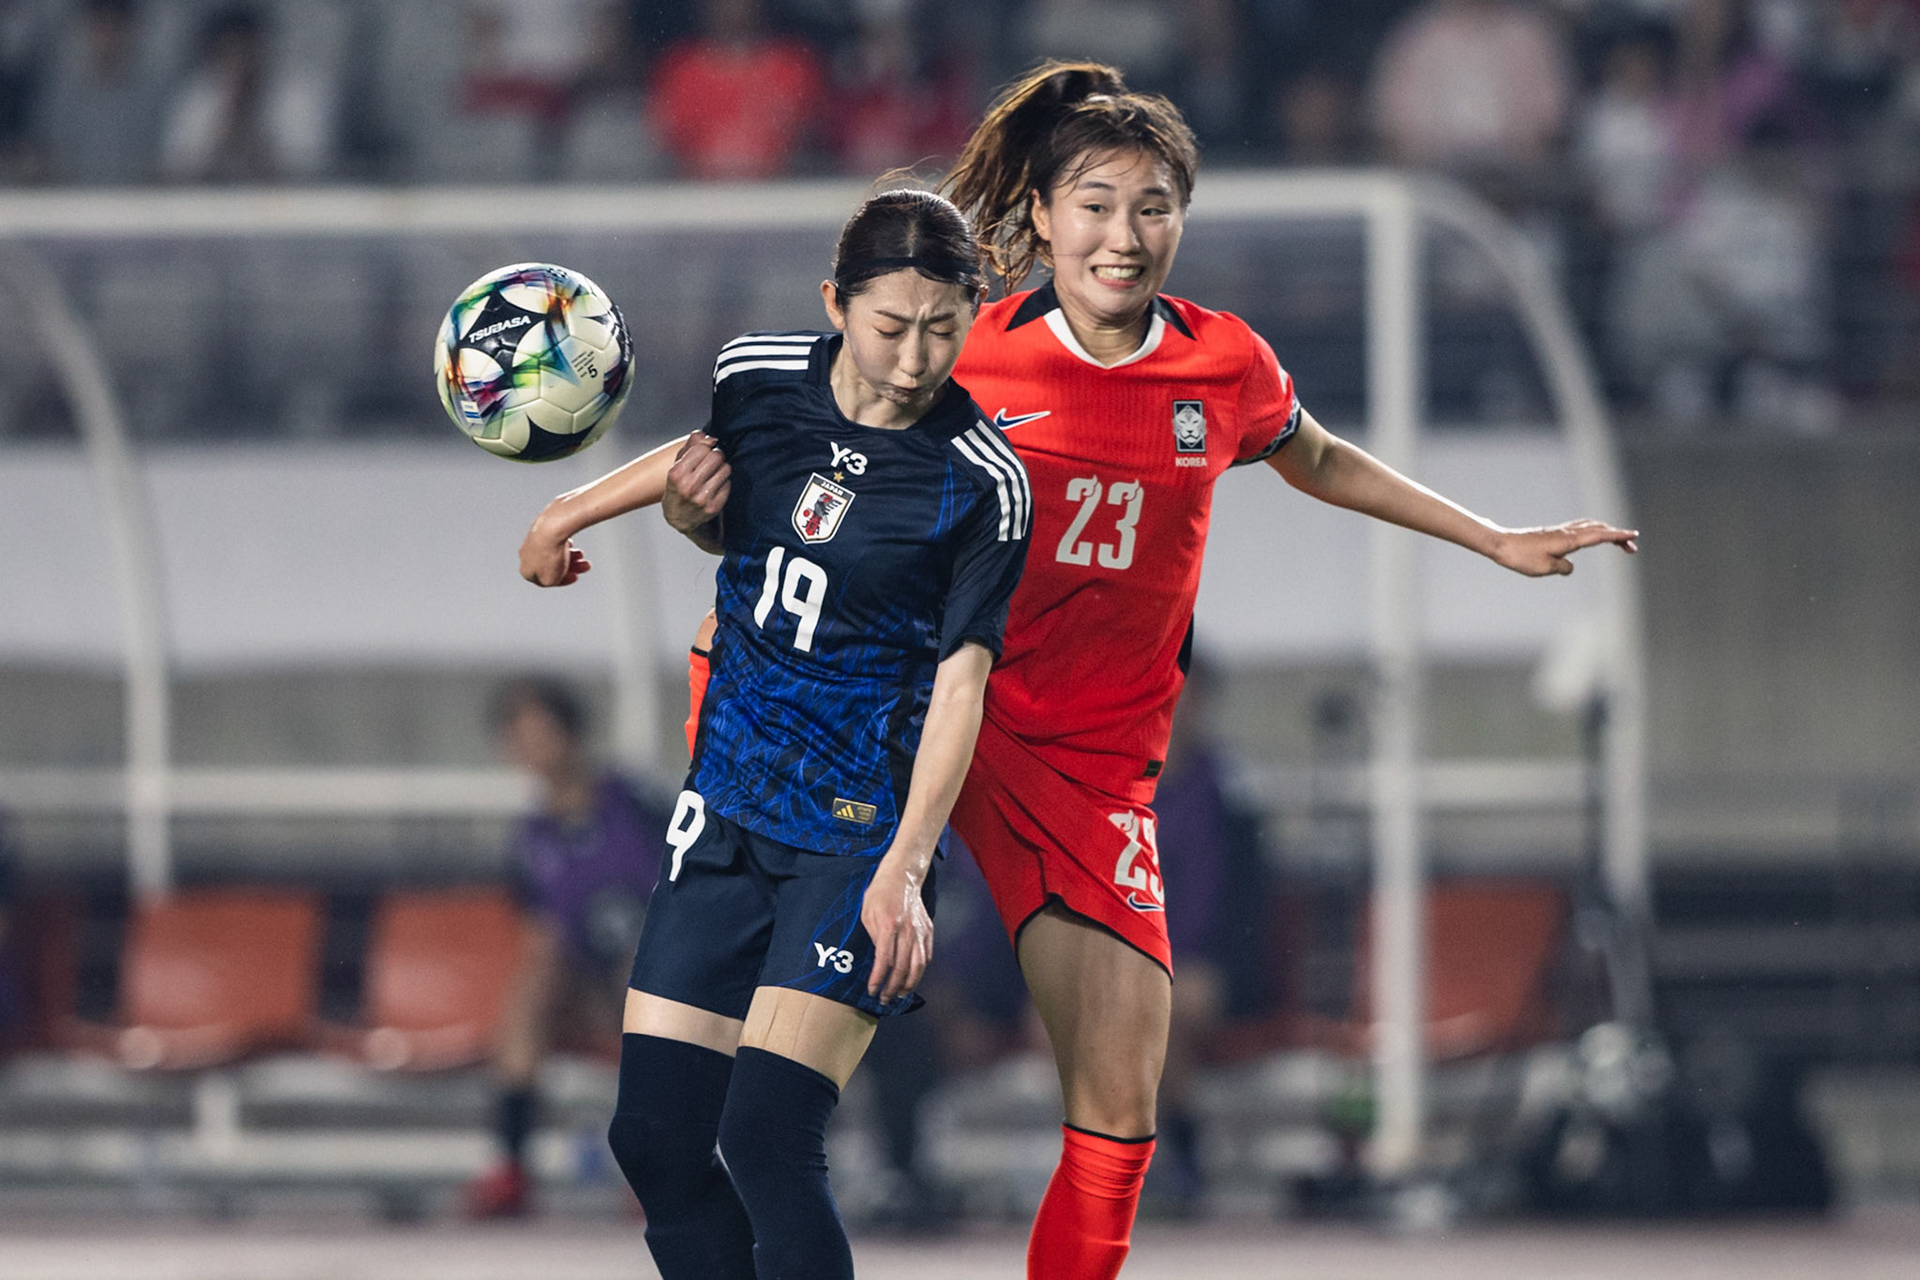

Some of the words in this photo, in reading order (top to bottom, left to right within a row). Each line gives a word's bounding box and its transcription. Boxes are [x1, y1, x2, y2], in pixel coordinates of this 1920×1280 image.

[469, 315, 531, 343] TSUBASA
[587, 364, 598, 378] 5
[830, 441, 868, 475] Y-3
[1175, 457, 1208, 467] KOREA
[820, 481, 845, 496] JAPAN
[1055, 474, 1145, 570] 23
[754, 546, 828, 653] 19
[666, 790, 706, 882] 9
[814, 942, 854, 974] Y-3
